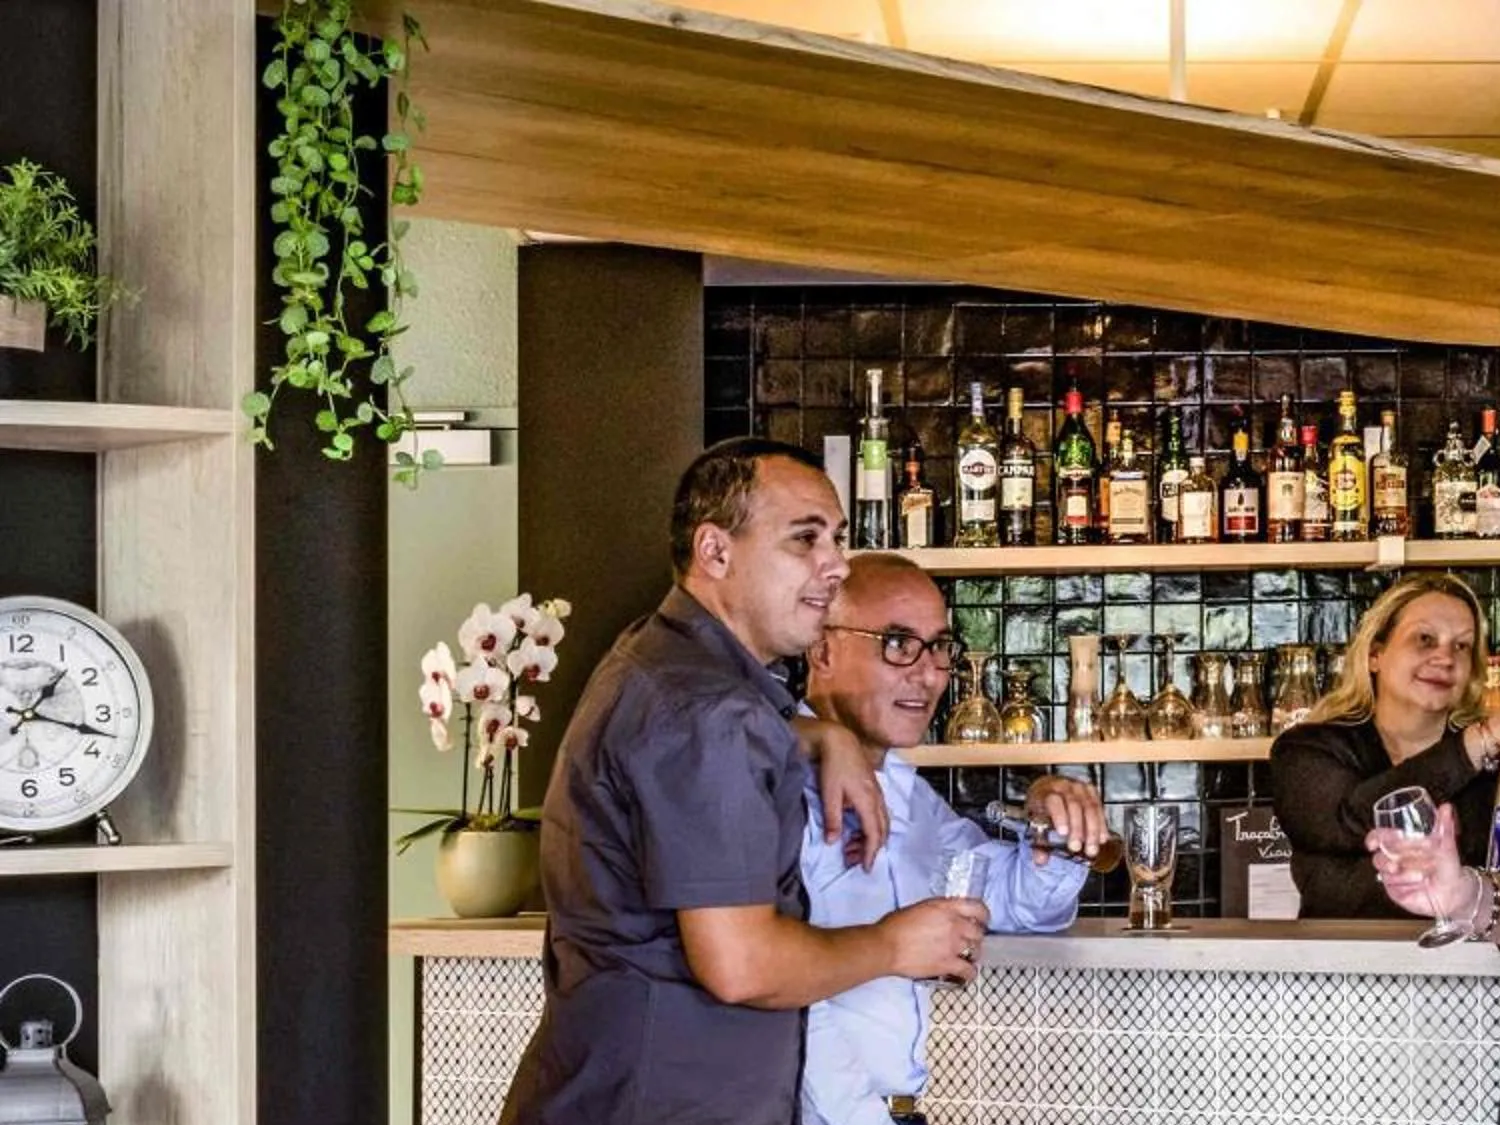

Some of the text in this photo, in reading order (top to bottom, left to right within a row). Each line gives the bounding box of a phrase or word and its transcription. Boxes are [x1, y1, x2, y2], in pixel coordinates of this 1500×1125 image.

[10, 634, 34, 653] 12
[59, 644, 65, 662] 1
[81, 667, 98, 686] 2
[95, 704, 111, 722] 3
[83, 741, 101, 758] 4
[59, 768, 76, 786] 5
[21, 779, 38, 798] 6
